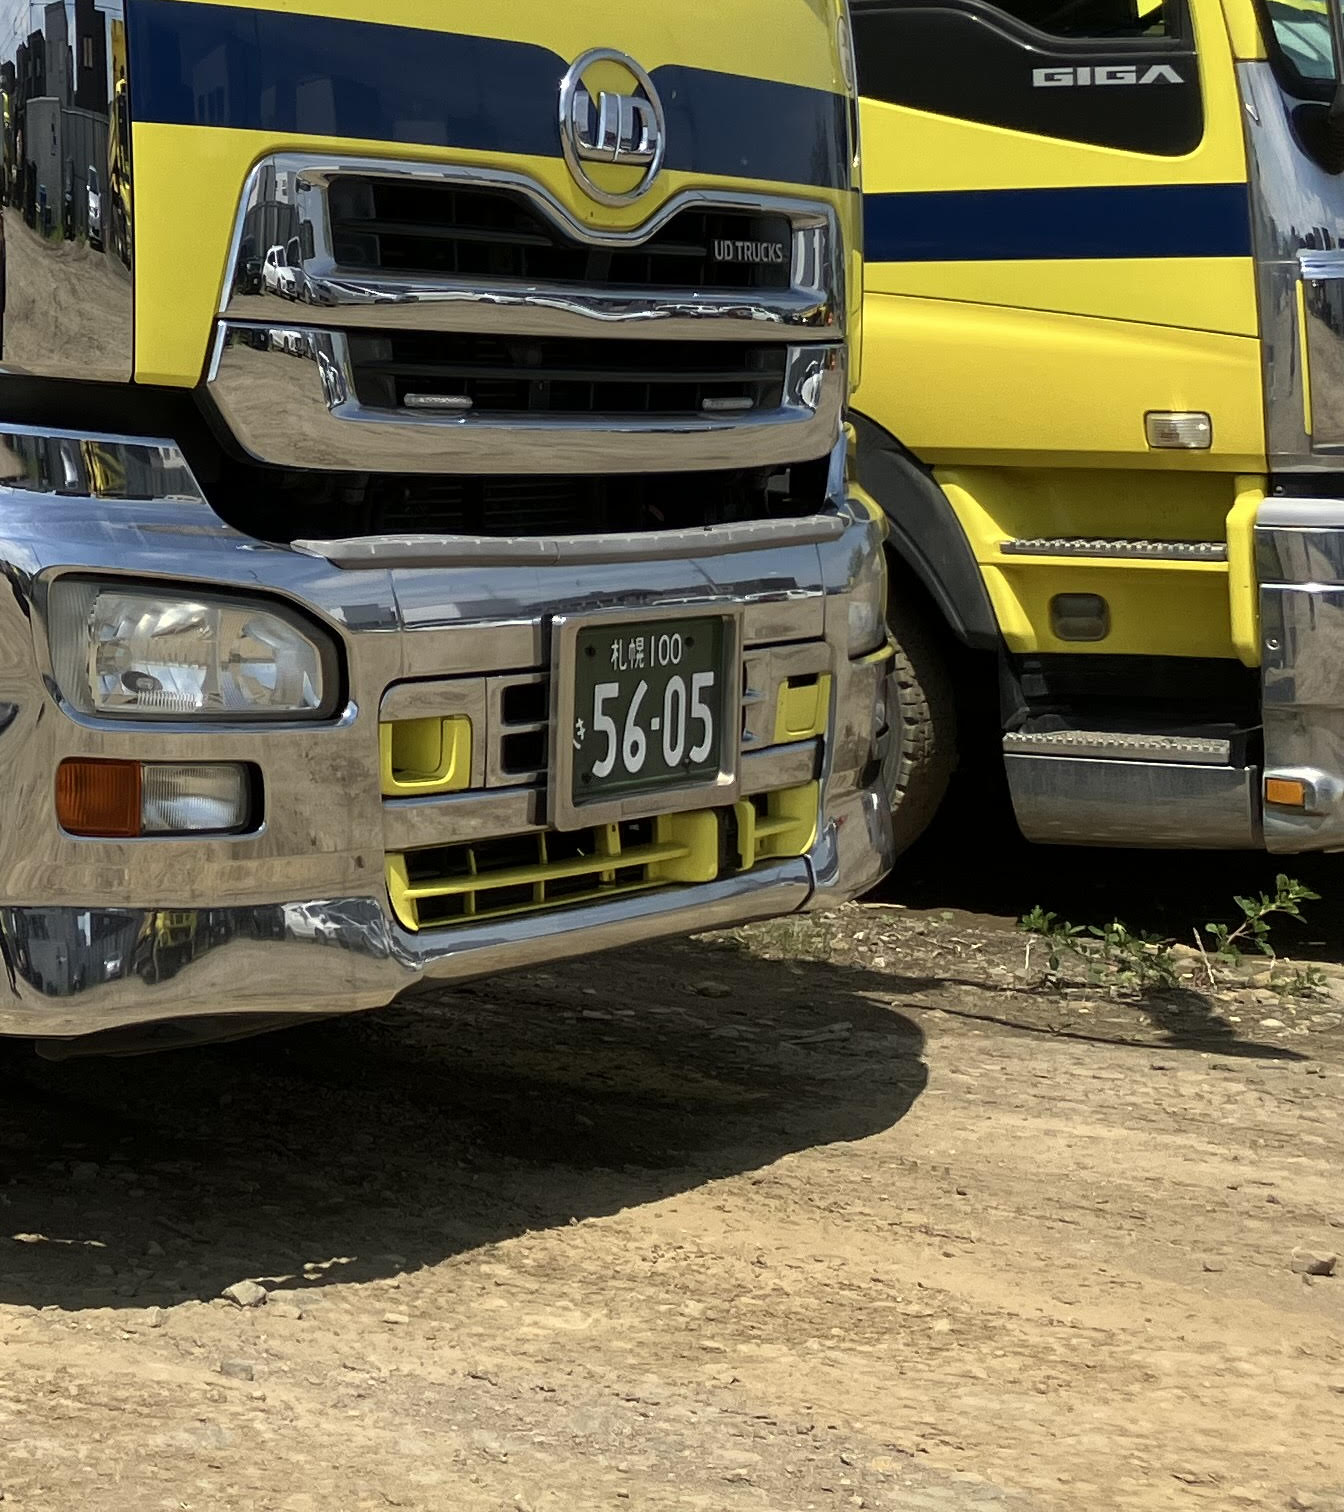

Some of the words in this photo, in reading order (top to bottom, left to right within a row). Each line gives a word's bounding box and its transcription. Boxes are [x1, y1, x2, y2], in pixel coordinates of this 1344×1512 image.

[1032, 64, 1184, 87] GIGA
[714, 240, 733, 260] UD
[735, 241, 783, 262] TRUCKS
